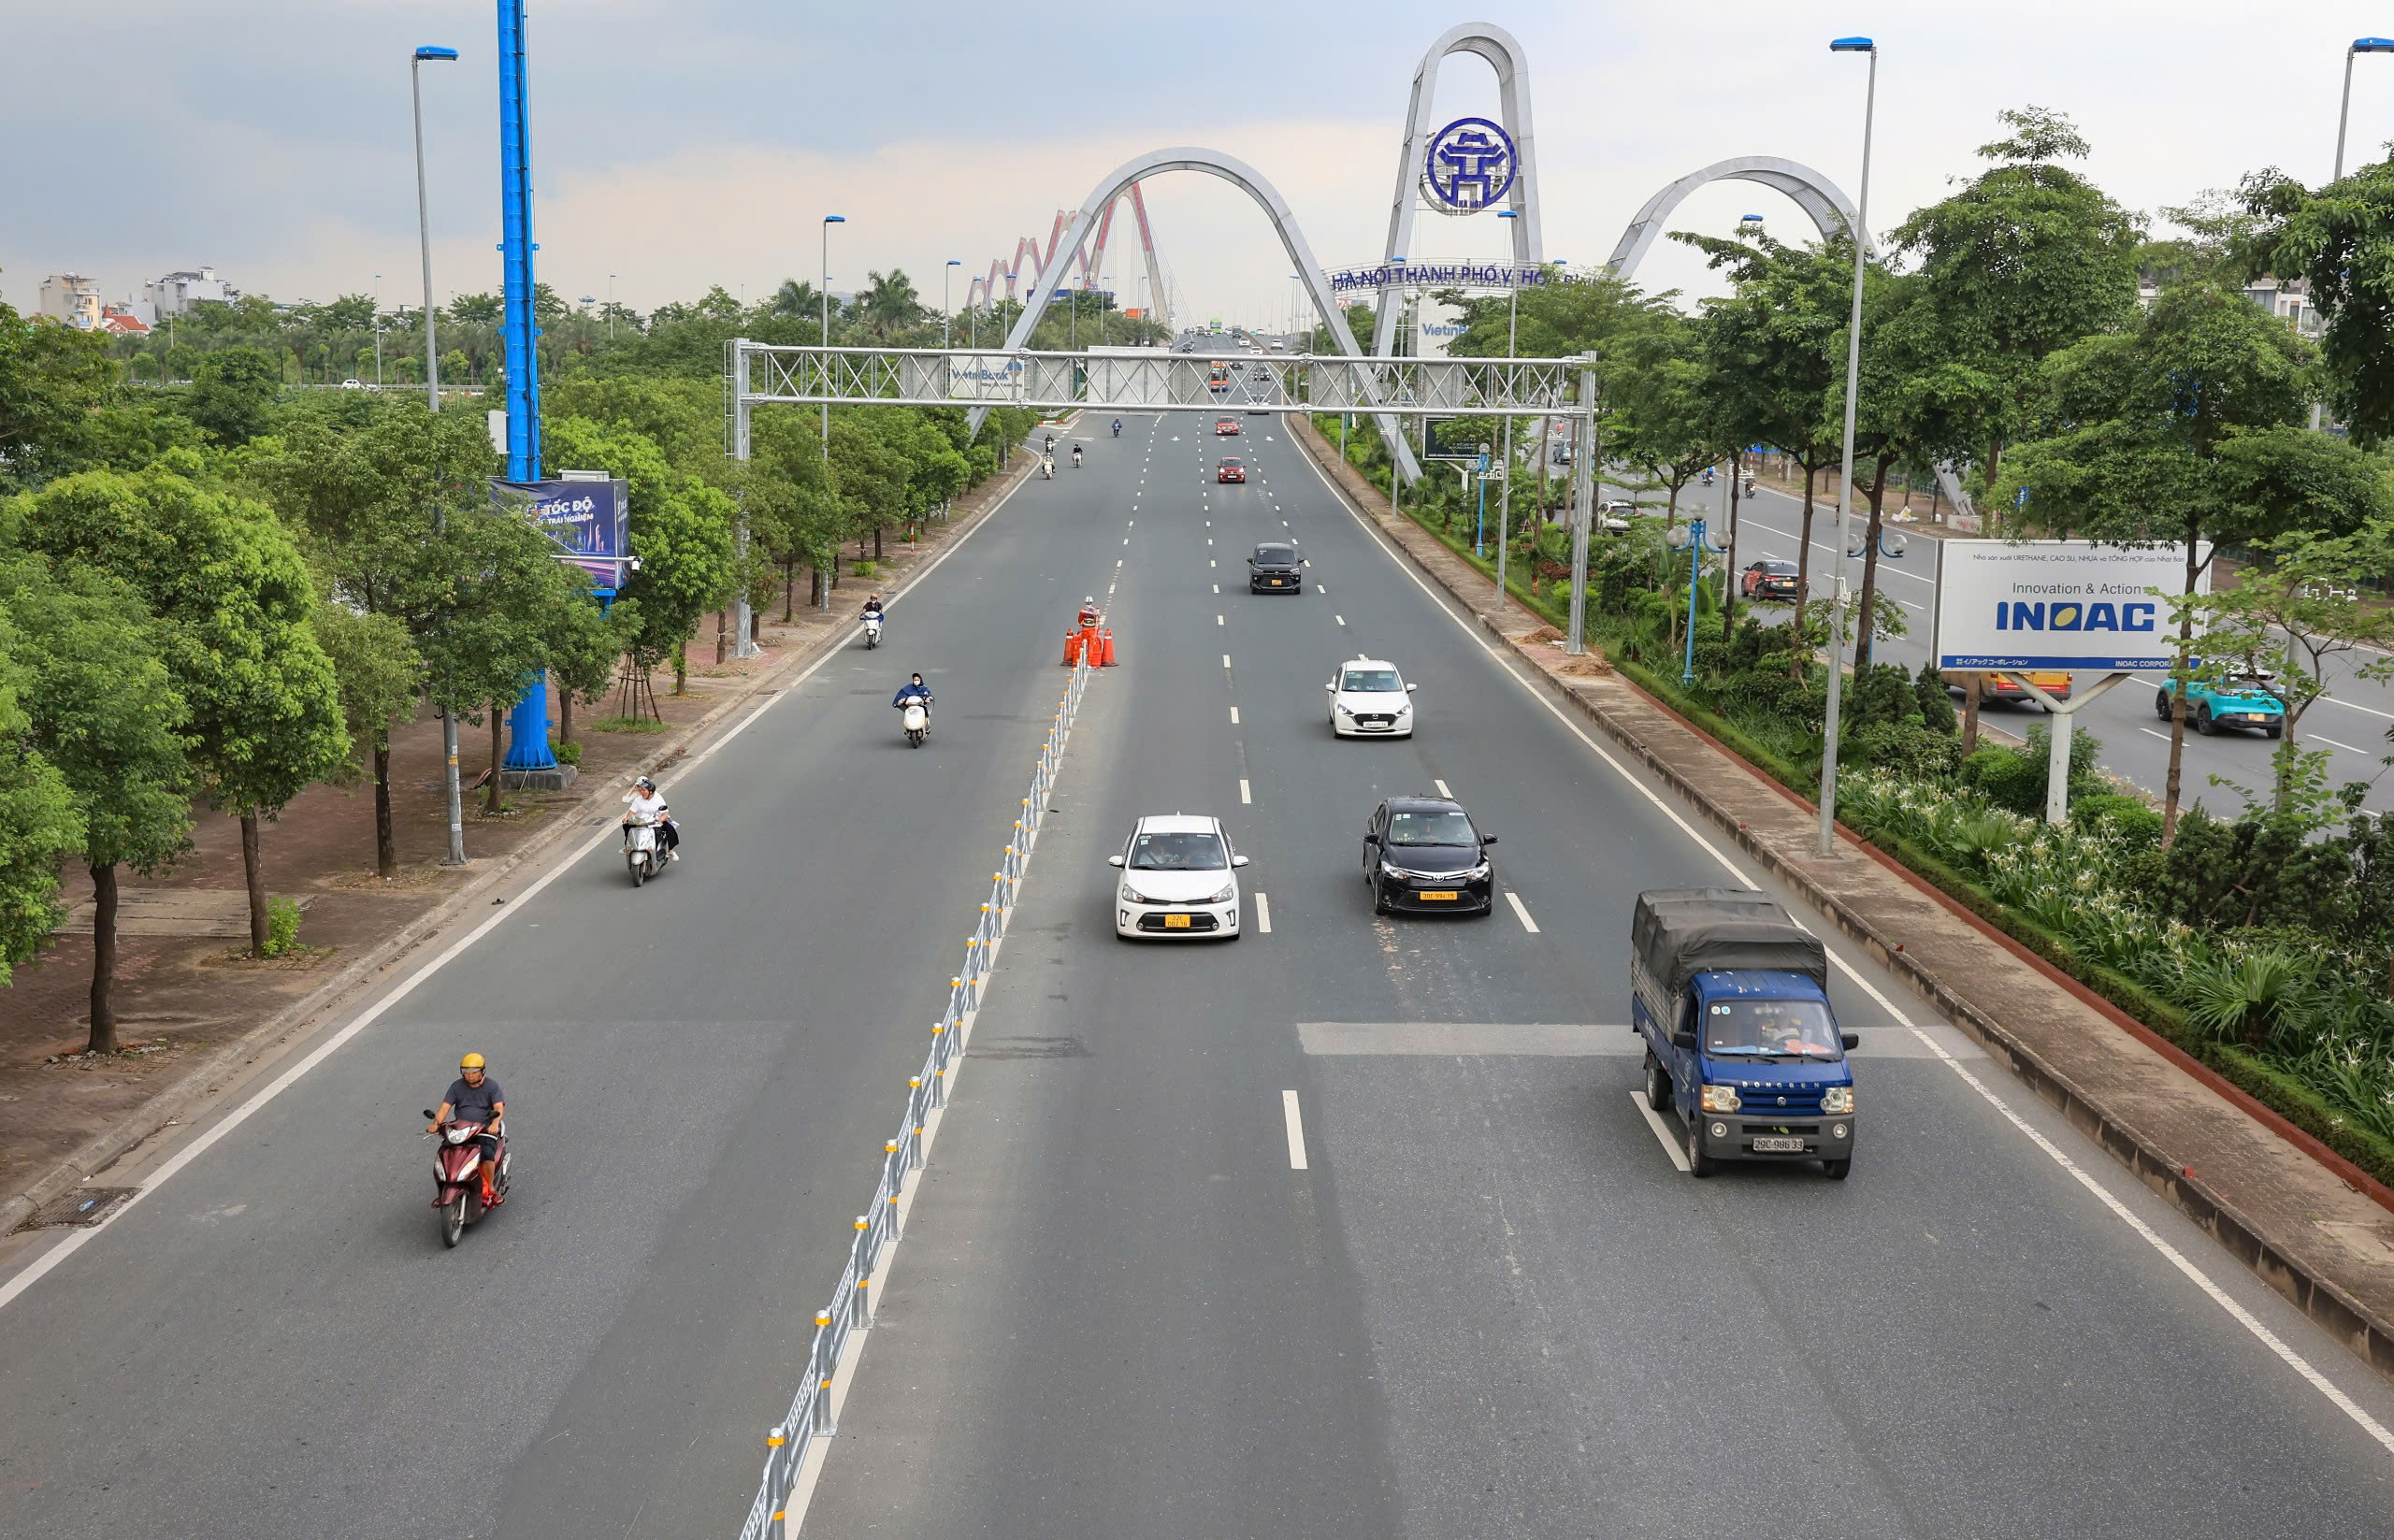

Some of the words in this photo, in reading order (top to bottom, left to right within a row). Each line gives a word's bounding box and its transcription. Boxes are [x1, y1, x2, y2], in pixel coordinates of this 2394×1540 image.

[1332, 270, 1357, 291] HÀ
[1362, 266, 1392, 287] NỘI
[1395, 265, 1455, 283] THÀNH
[1462, 263, 1497, 281] PHỐ
[1501, 268, 1517, 283] V
[2012, 554, 2048, 563] URETHANE,
[2012, 583, 2081, 595] Innovation
[2085, 583, 2095, 595] &
[2099, 583, 2142, 595] Action
[1996, 601, 2156, 632] INOAC
